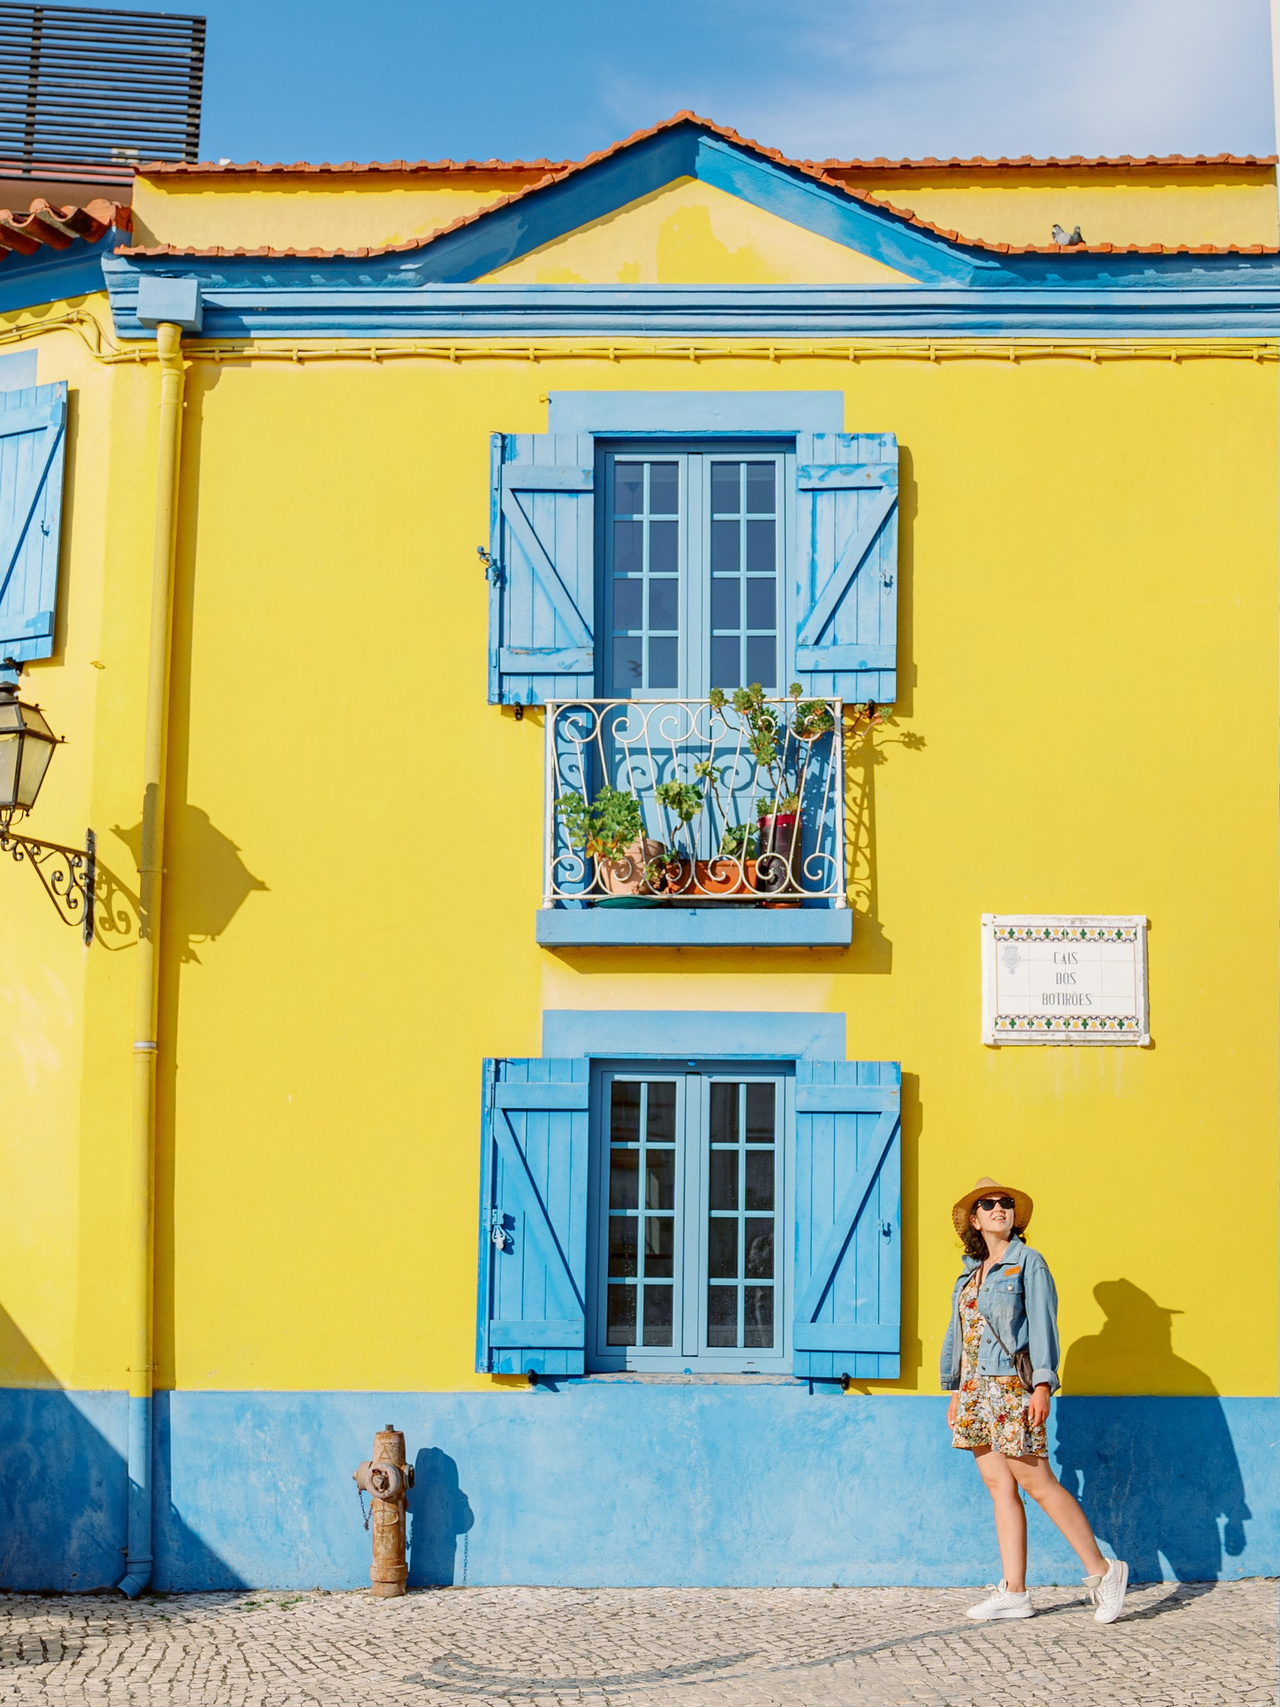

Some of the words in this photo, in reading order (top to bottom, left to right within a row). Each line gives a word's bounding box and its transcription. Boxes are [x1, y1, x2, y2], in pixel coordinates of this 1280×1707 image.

[1053, 951, 1079, 965] CAIS
[1055, 972, 1077, 985] DOS
[1041, 991, 1093, 1006] BOTIRÕES
